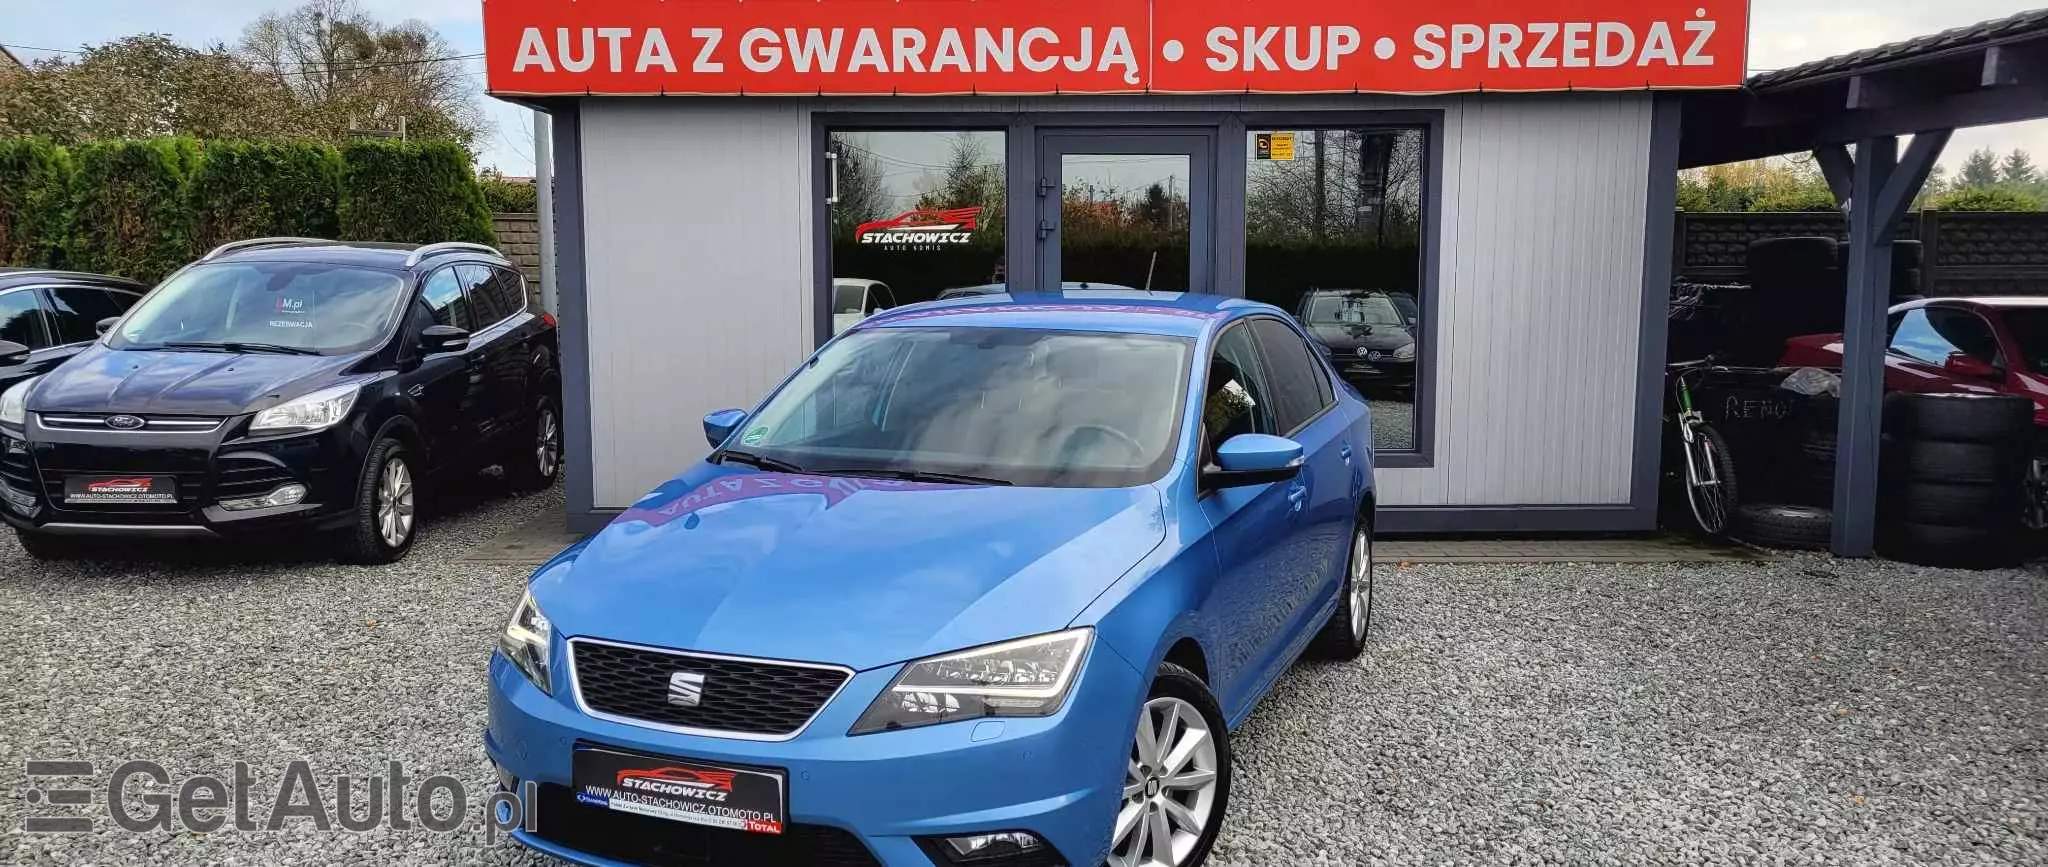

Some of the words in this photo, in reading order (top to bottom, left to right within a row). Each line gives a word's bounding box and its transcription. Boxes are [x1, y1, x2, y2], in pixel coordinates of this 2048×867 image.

[512, 27, 677, 73] AUTA
[692, 28, 724, 72] Z
[739, 27, 1141, 85] GWARANCJĄ
[1205, 25, 1361, 72] SKUP
[1413, 8, 1716, 70] SPRZEDAŻ
[861, 232, 972, 244] STACHOWICZ
[913, 244, 941, 252] KOMIS
[622, 777, 728, 802] STACHOWICZ
[585, 785, 777, 823] WWW.AUTO-STACHOWICZ.OTOMOTO.PL
[749, 822, 781, 834] TOTAL
